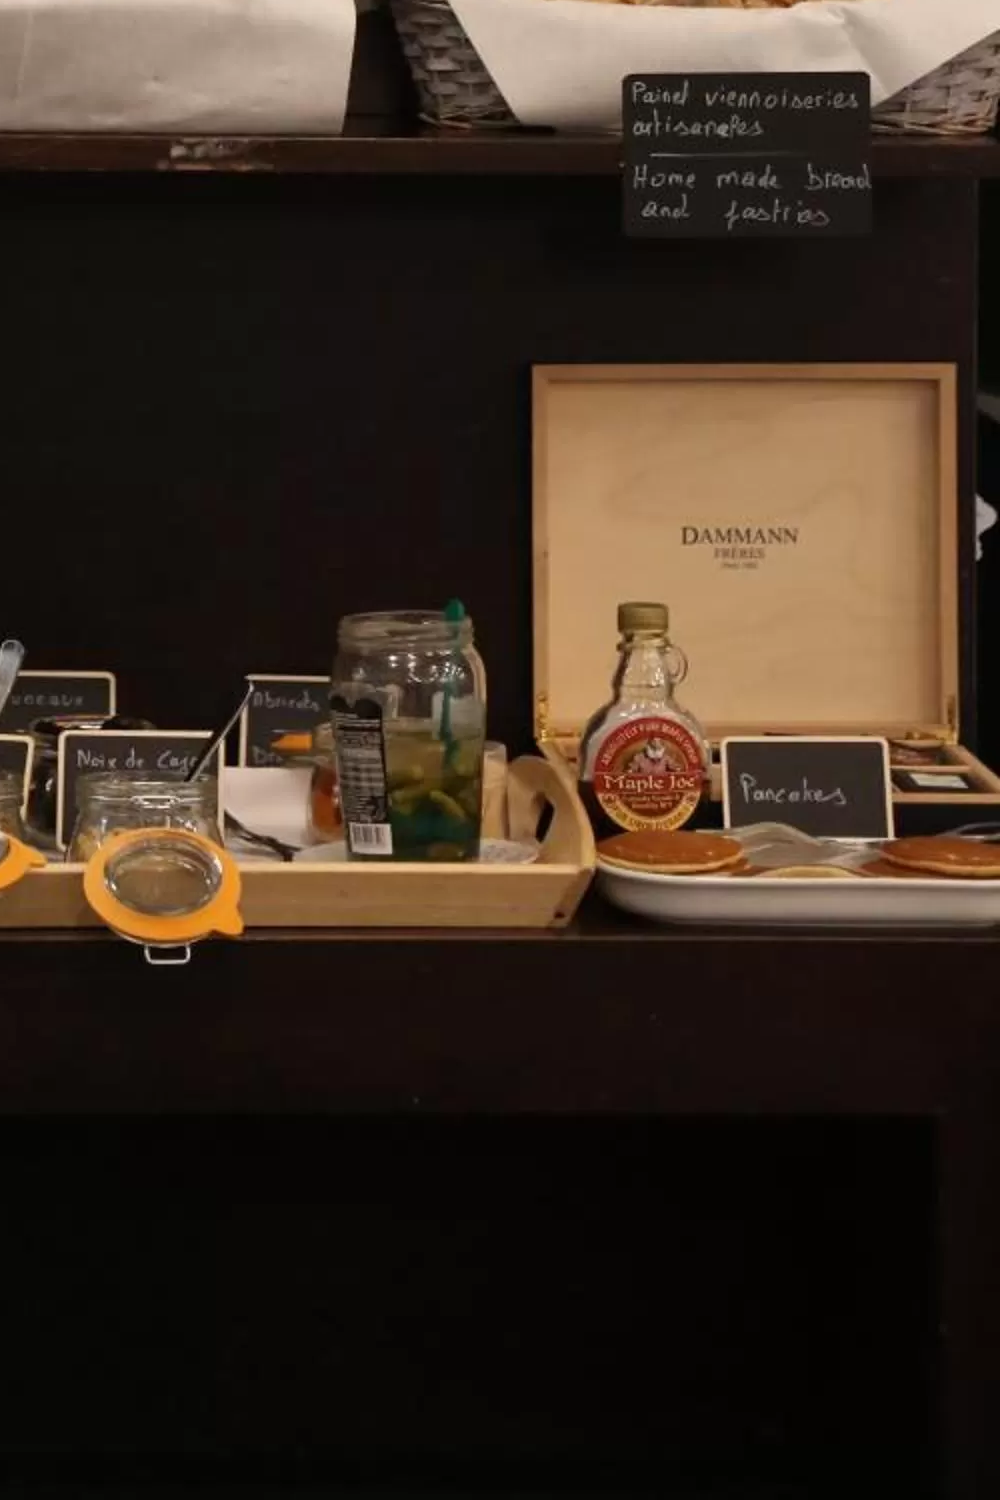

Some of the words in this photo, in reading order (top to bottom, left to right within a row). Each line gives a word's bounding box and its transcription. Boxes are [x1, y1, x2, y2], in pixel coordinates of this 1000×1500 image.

[632, 164, 697, 189] Home
[716, 164, 782, 189] made
[804, 163, 872, 190] bread
[640, 193, 691, 218] and
[681, 526, 799, 545] DAMMANN
[76, 748, 118, 769] Noix
[603, 774, 665, 793] Maple
[669, 774, 696, 790] Joe
[739, 773, 848, 805] Pancakes
